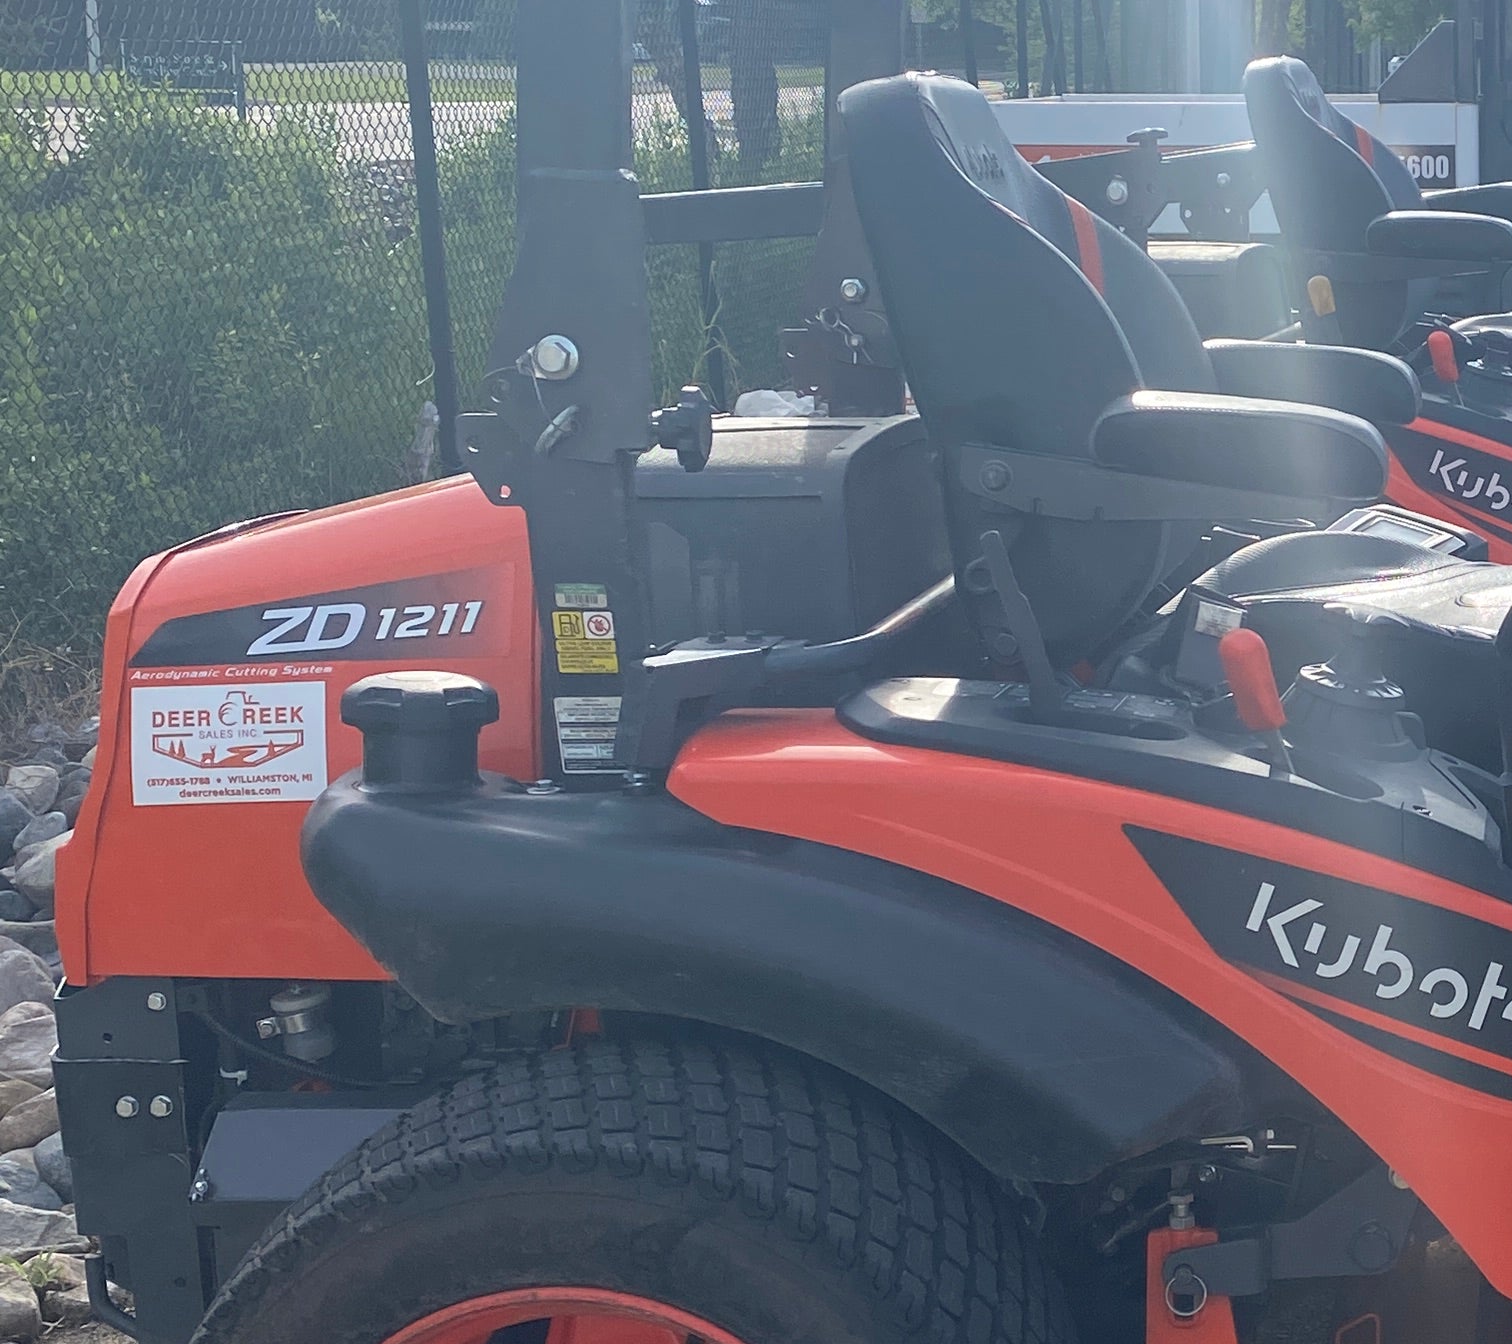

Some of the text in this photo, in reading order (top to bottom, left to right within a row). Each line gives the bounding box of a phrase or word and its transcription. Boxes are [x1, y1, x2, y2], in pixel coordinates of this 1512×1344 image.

[1400, 155, 1449, 179] 600
[246, 601, 483, 656] ZD 1211
[130, 664, 333, 681] Aerodynamic Cutting System
[152, 709, 211, 728] DEER
[198, 729, 233, 739] SALES
[228, 773, 300, 784] WILLIAMSTON,
[302, 773, 312, 782] MI
[179, 787, 281, 798] deercreeksales.com
